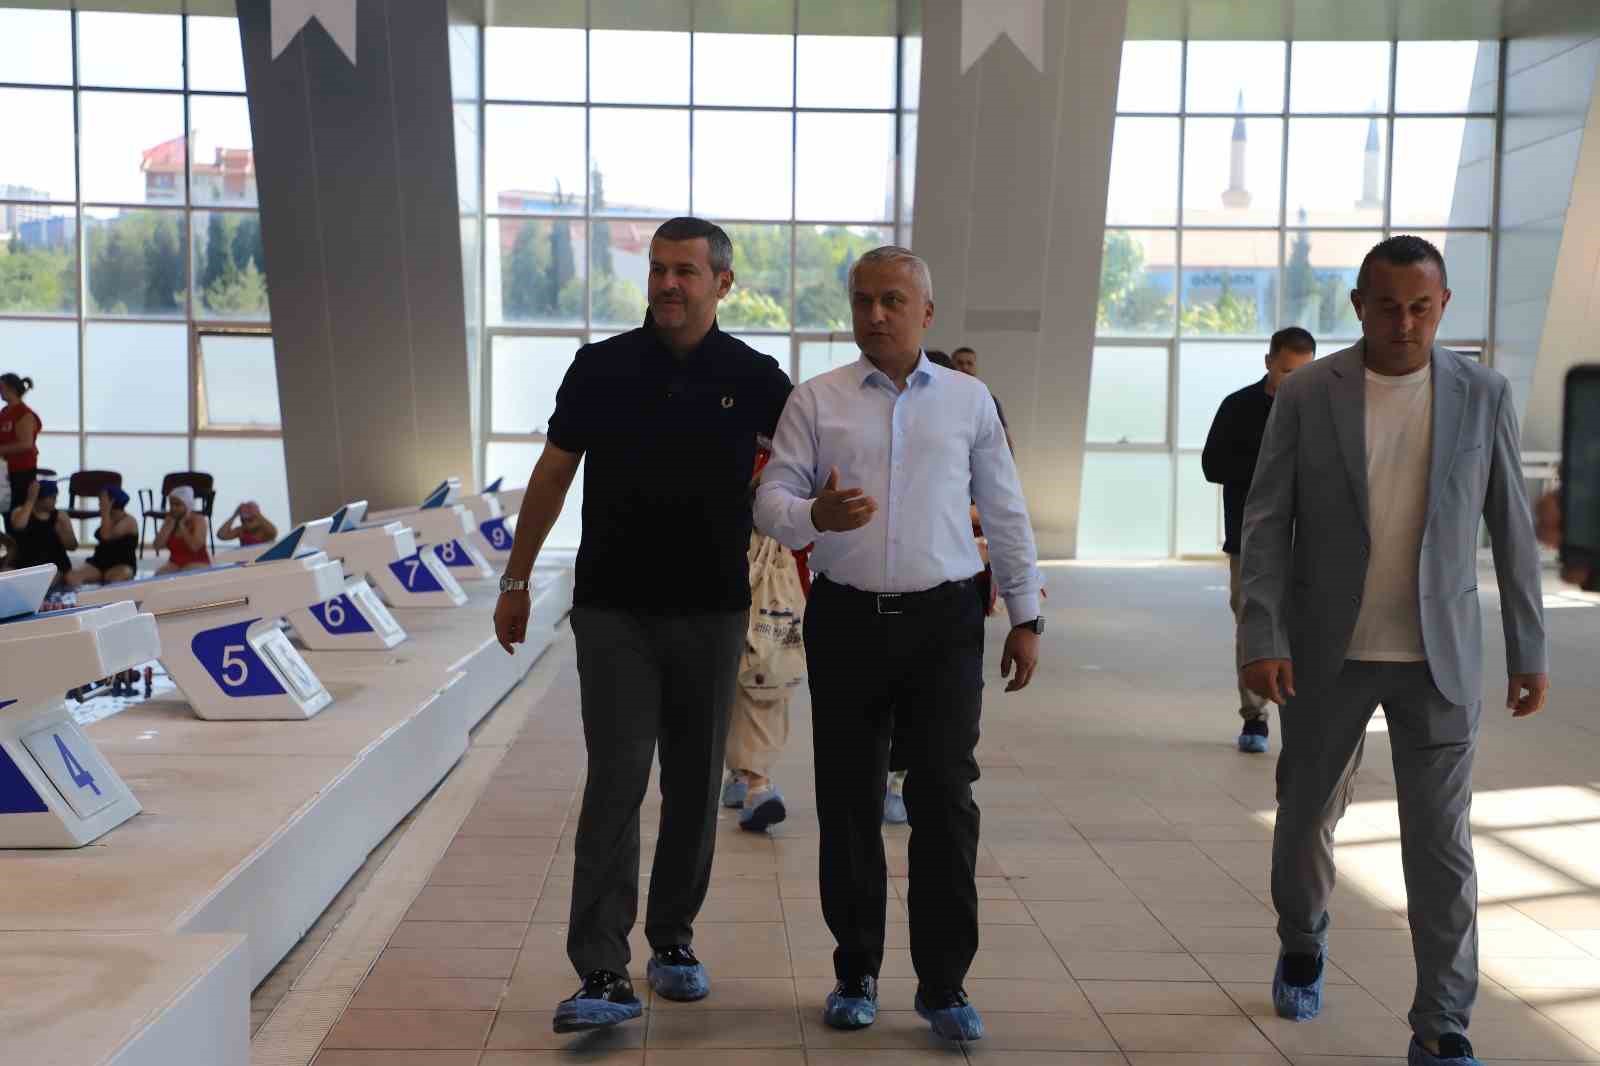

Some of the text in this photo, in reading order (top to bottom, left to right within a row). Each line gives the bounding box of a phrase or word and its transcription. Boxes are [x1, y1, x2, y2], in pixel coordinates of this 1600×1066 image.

[492, 527, 505, 547] 9
[442, 542, 456, 562] 8
[404, 560, 419, 588] 7
[324, 597, 345, 627] 6
[222, 645, 248, 686] 5
[53, 734, 101, 795] 4
